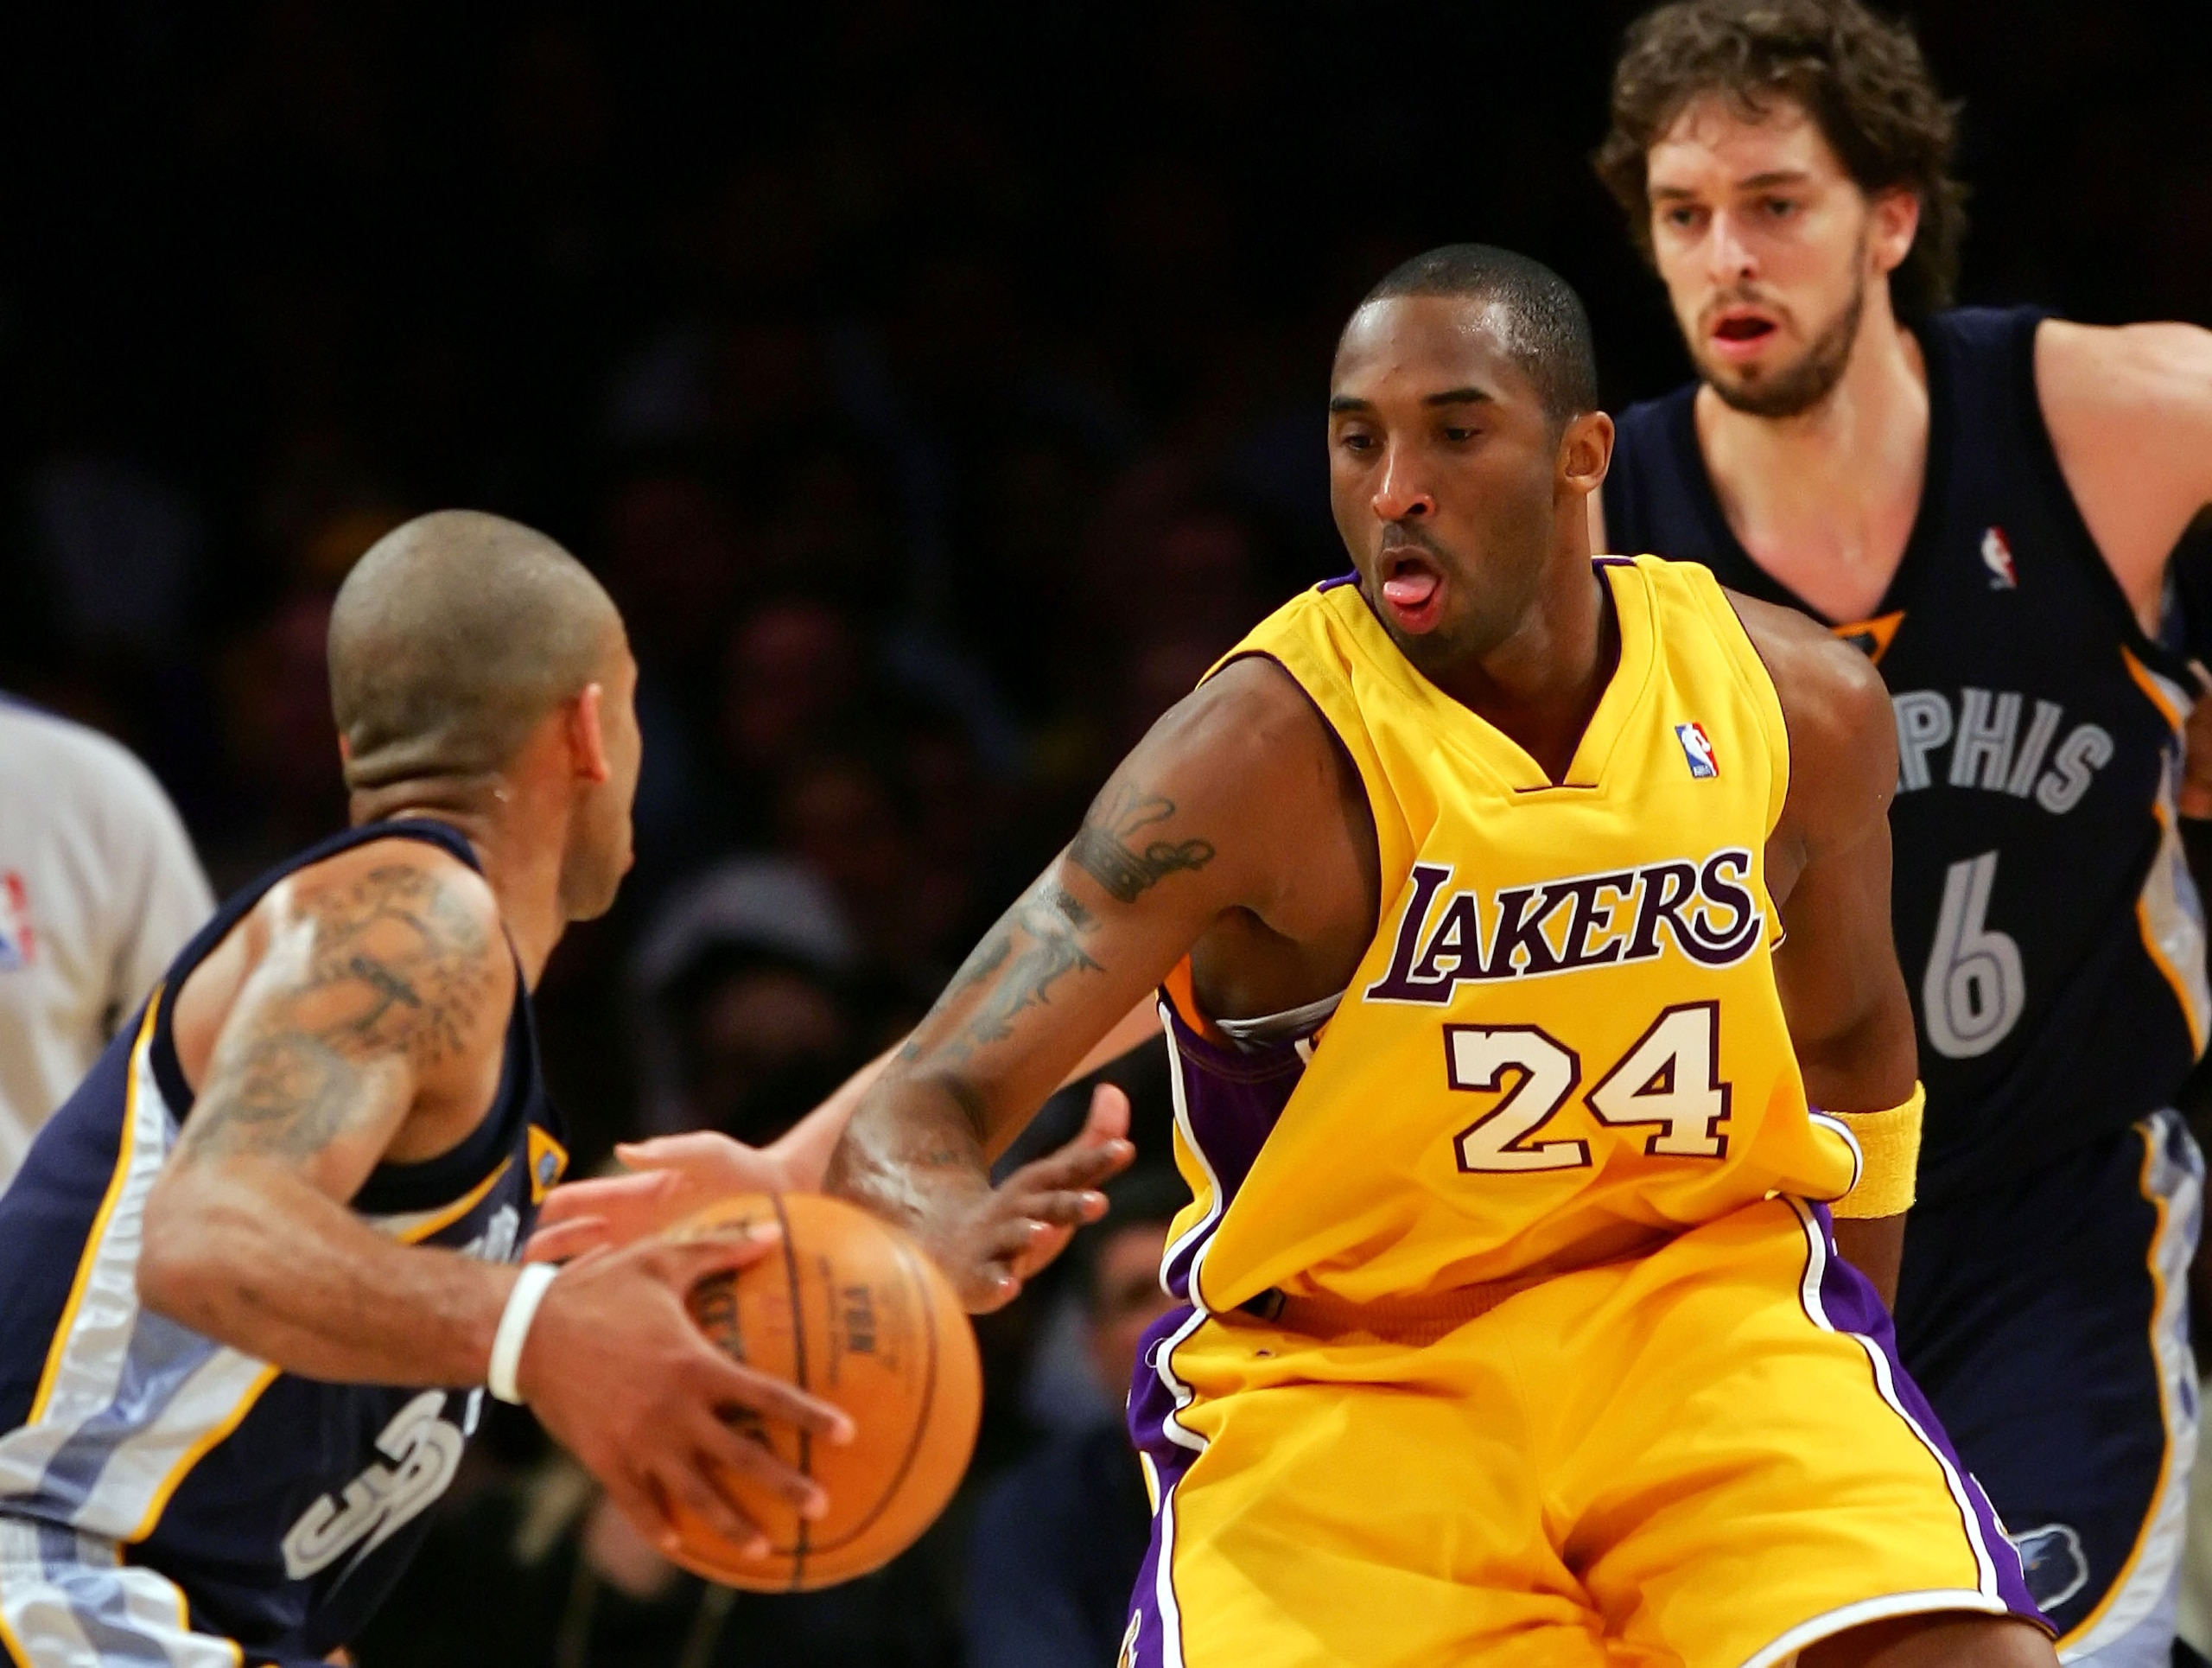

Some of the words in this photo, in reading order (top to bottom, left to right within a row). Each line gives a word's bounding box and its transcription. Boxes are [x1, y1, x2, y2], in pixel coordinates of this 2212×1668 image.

[1894, 687, 2114, 814] PHIS
[1362, 846, 1764, 1007] LAKERS
[1923, 850, 2025, 1059] 6
[1442, 1000, 1732, 1173] 24
[281, 1387, 484, 1581] 3
